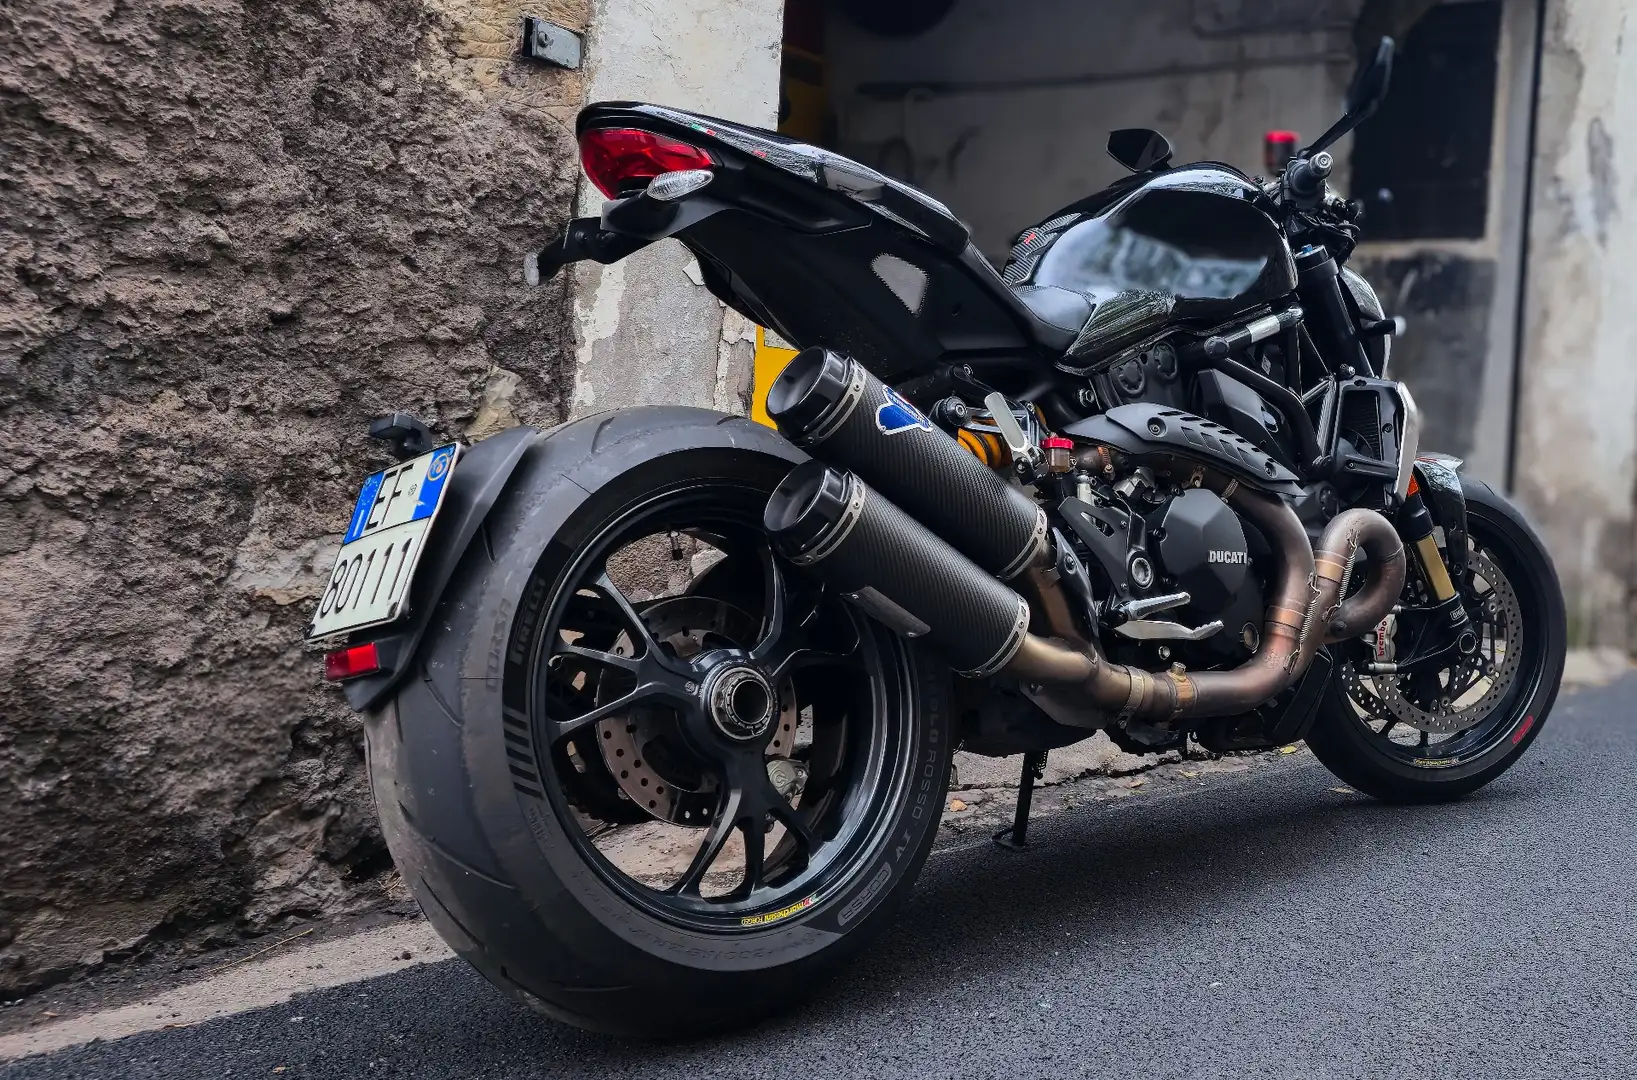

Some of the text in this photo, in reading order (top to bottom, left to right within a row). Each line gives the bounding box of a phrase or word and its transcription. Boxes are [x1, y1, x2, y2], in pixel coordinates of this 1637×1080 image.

[365, 463, 415, 531] EF
[320, 537, 413, 619] 80111
[1208, 550, 1248, 564] DUCATI
[508, 576, 547, 666] PIRELLI
[1377, 620, 1388, 657] brembo
[911, 749, 938, 820] ROSSO
